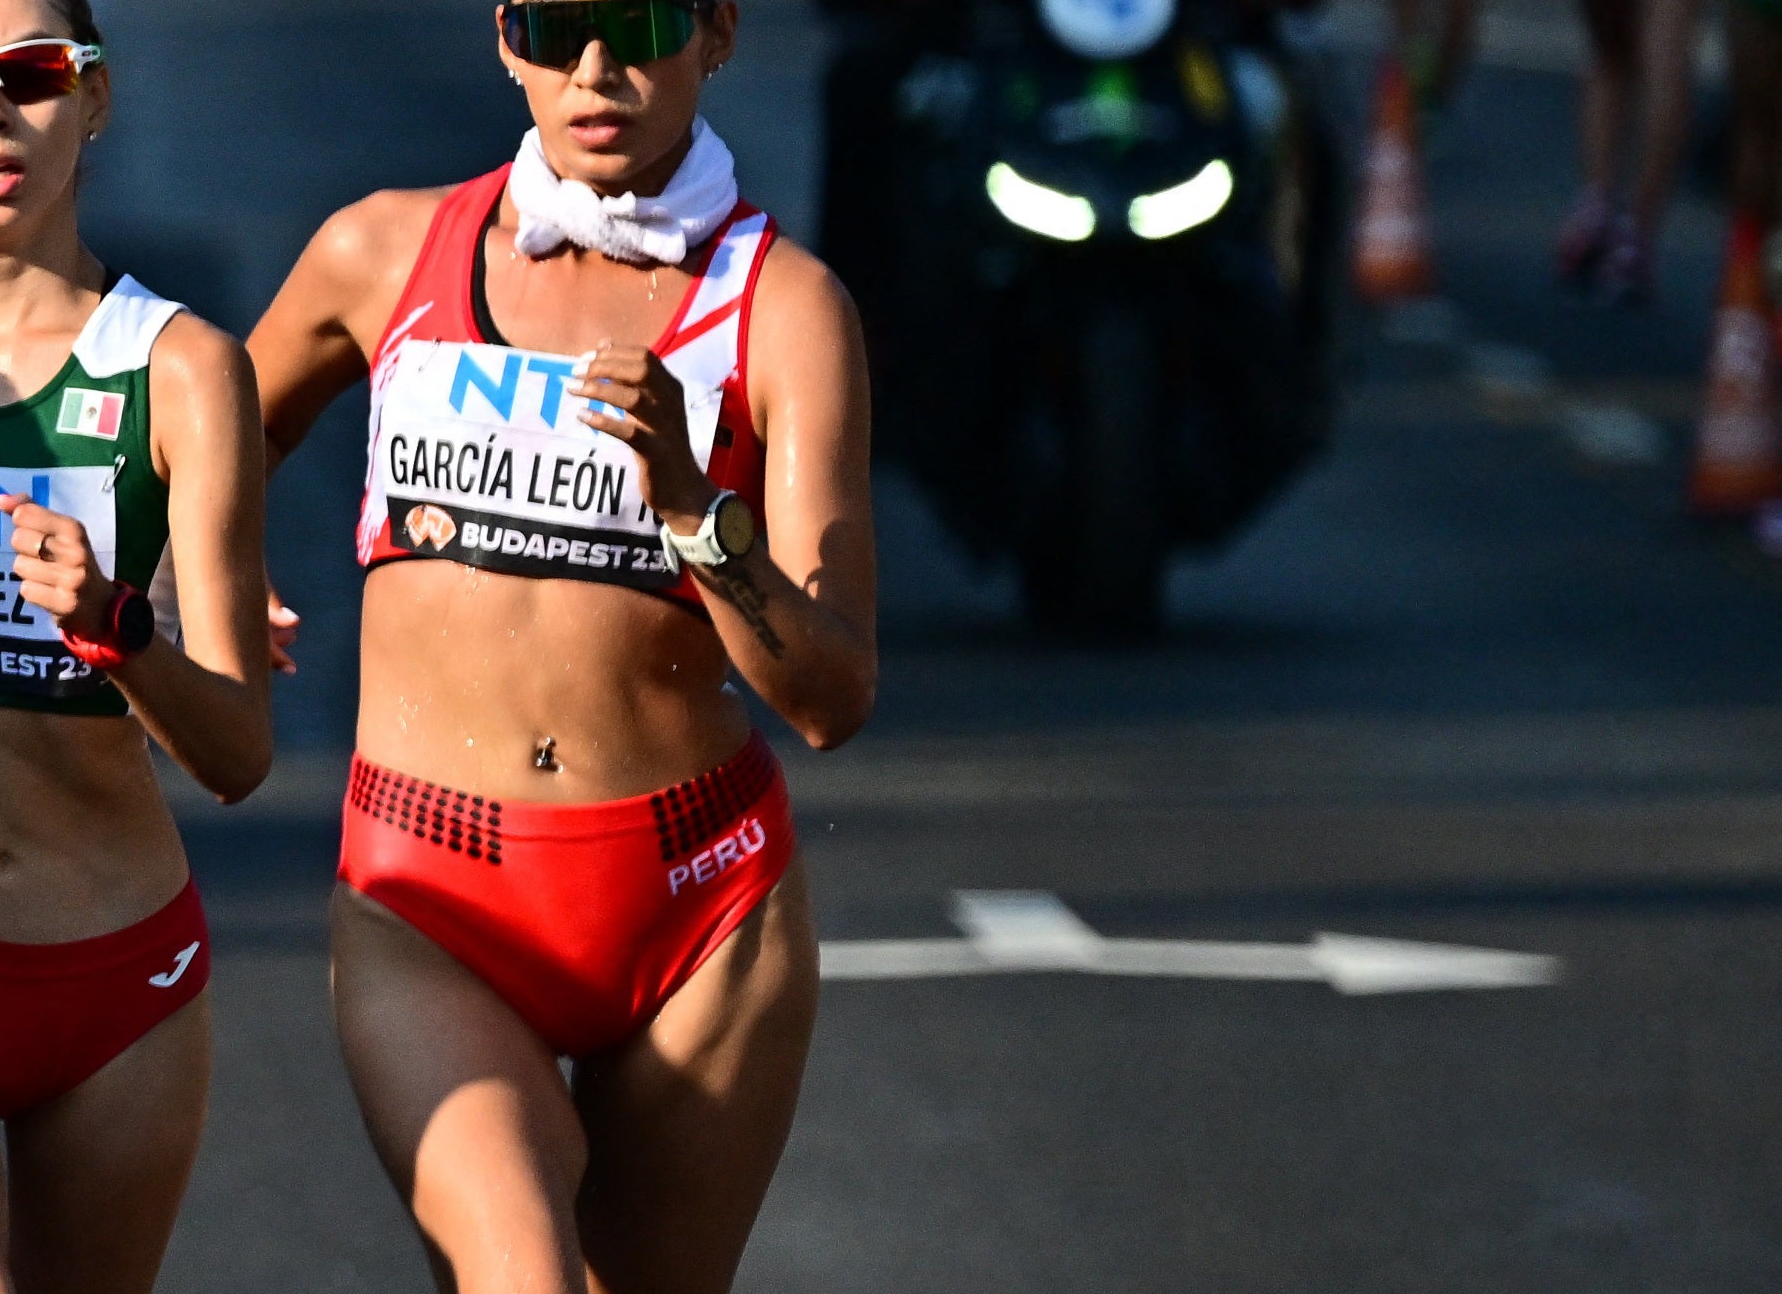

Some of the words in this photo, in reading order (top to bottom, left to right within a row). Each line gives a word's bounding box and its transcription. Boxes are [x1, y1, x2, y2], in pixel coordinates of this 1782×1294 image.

[448, 349, 625, 435] NT
[389, 431, 513, 500] GARCÍA
[526, 447, 626, 516] LEÓN
[460, 522, 628, 568] BUDAPEST
[632, 546, 665, 572] 23
[668, 819, 766, 896] PERÚ
